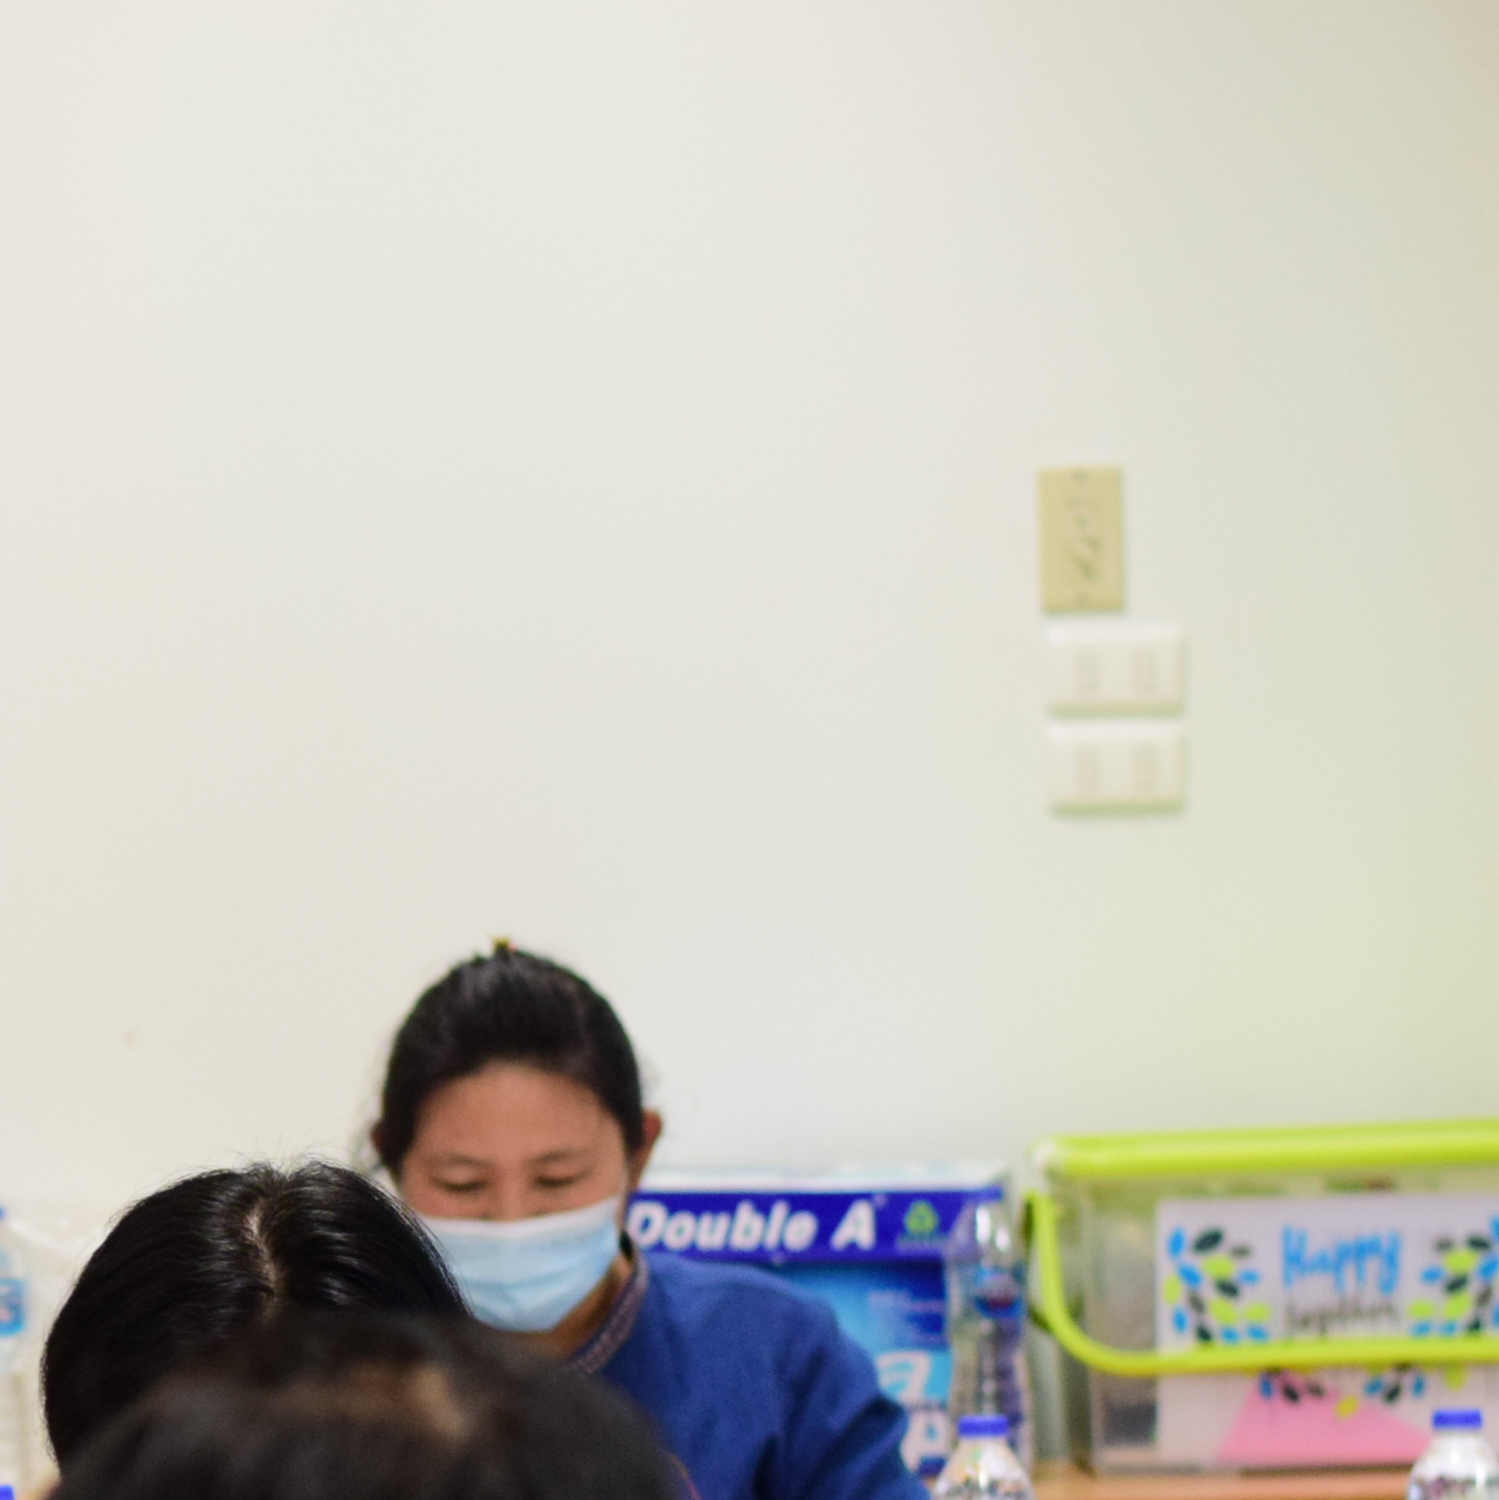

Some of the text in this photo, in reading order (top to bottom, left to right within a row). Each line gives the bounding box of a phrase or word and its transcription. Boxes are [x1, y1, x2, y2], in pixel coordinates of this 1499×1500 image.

[627, 1200, 877, 1251] Double A
[1282, 1226, 1400, 1295] Happy
